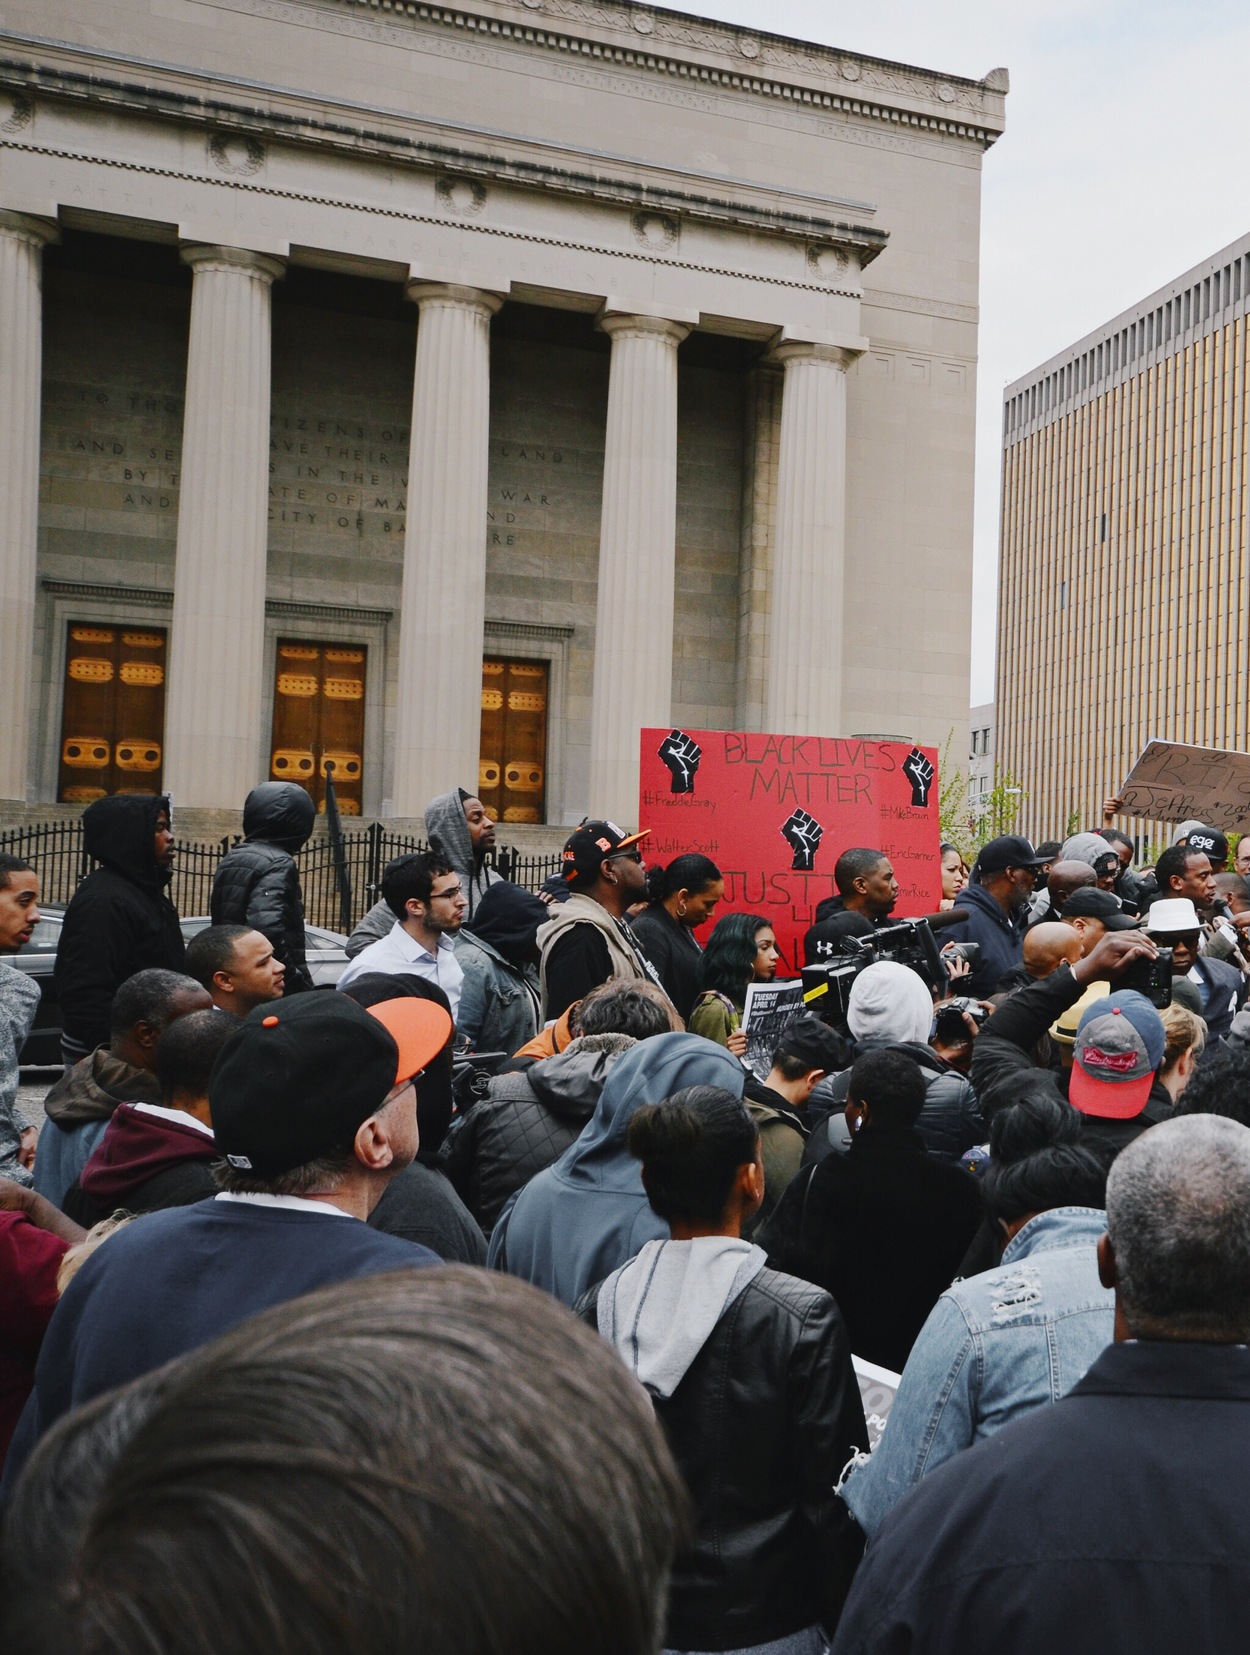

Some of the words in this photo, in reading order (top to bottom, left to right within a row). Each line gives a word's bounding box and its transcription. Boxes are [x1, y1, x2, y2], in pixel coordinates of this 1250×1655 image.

[270, 413, 365, 439] TIZENS
[269, 438, 309, 455] AVE
[324, 445, 389, 465] THEIR
[76, 439, 124, 456] AND
[338, 470, 380, 486] THE
[501, 490, 550, 506] WAR
[123, 468, 148, 482] BY
[326, 492, 356, 505] OF
[123, 492, 170, 509] AND
[724, 733, 809, 765] BLACK
[818, 737, 895, 771] LIVES
[750, 768, 873, 805] MATTER
[642, 790, 716, 815] #FreddieGray
[640, 837, 719, 853] #WalterScott
[721, 871, 836, 905] JUSTI
[752, 1000, 769, 1009] APRIL
[753, 992, 779, 1001] TUESDAY
